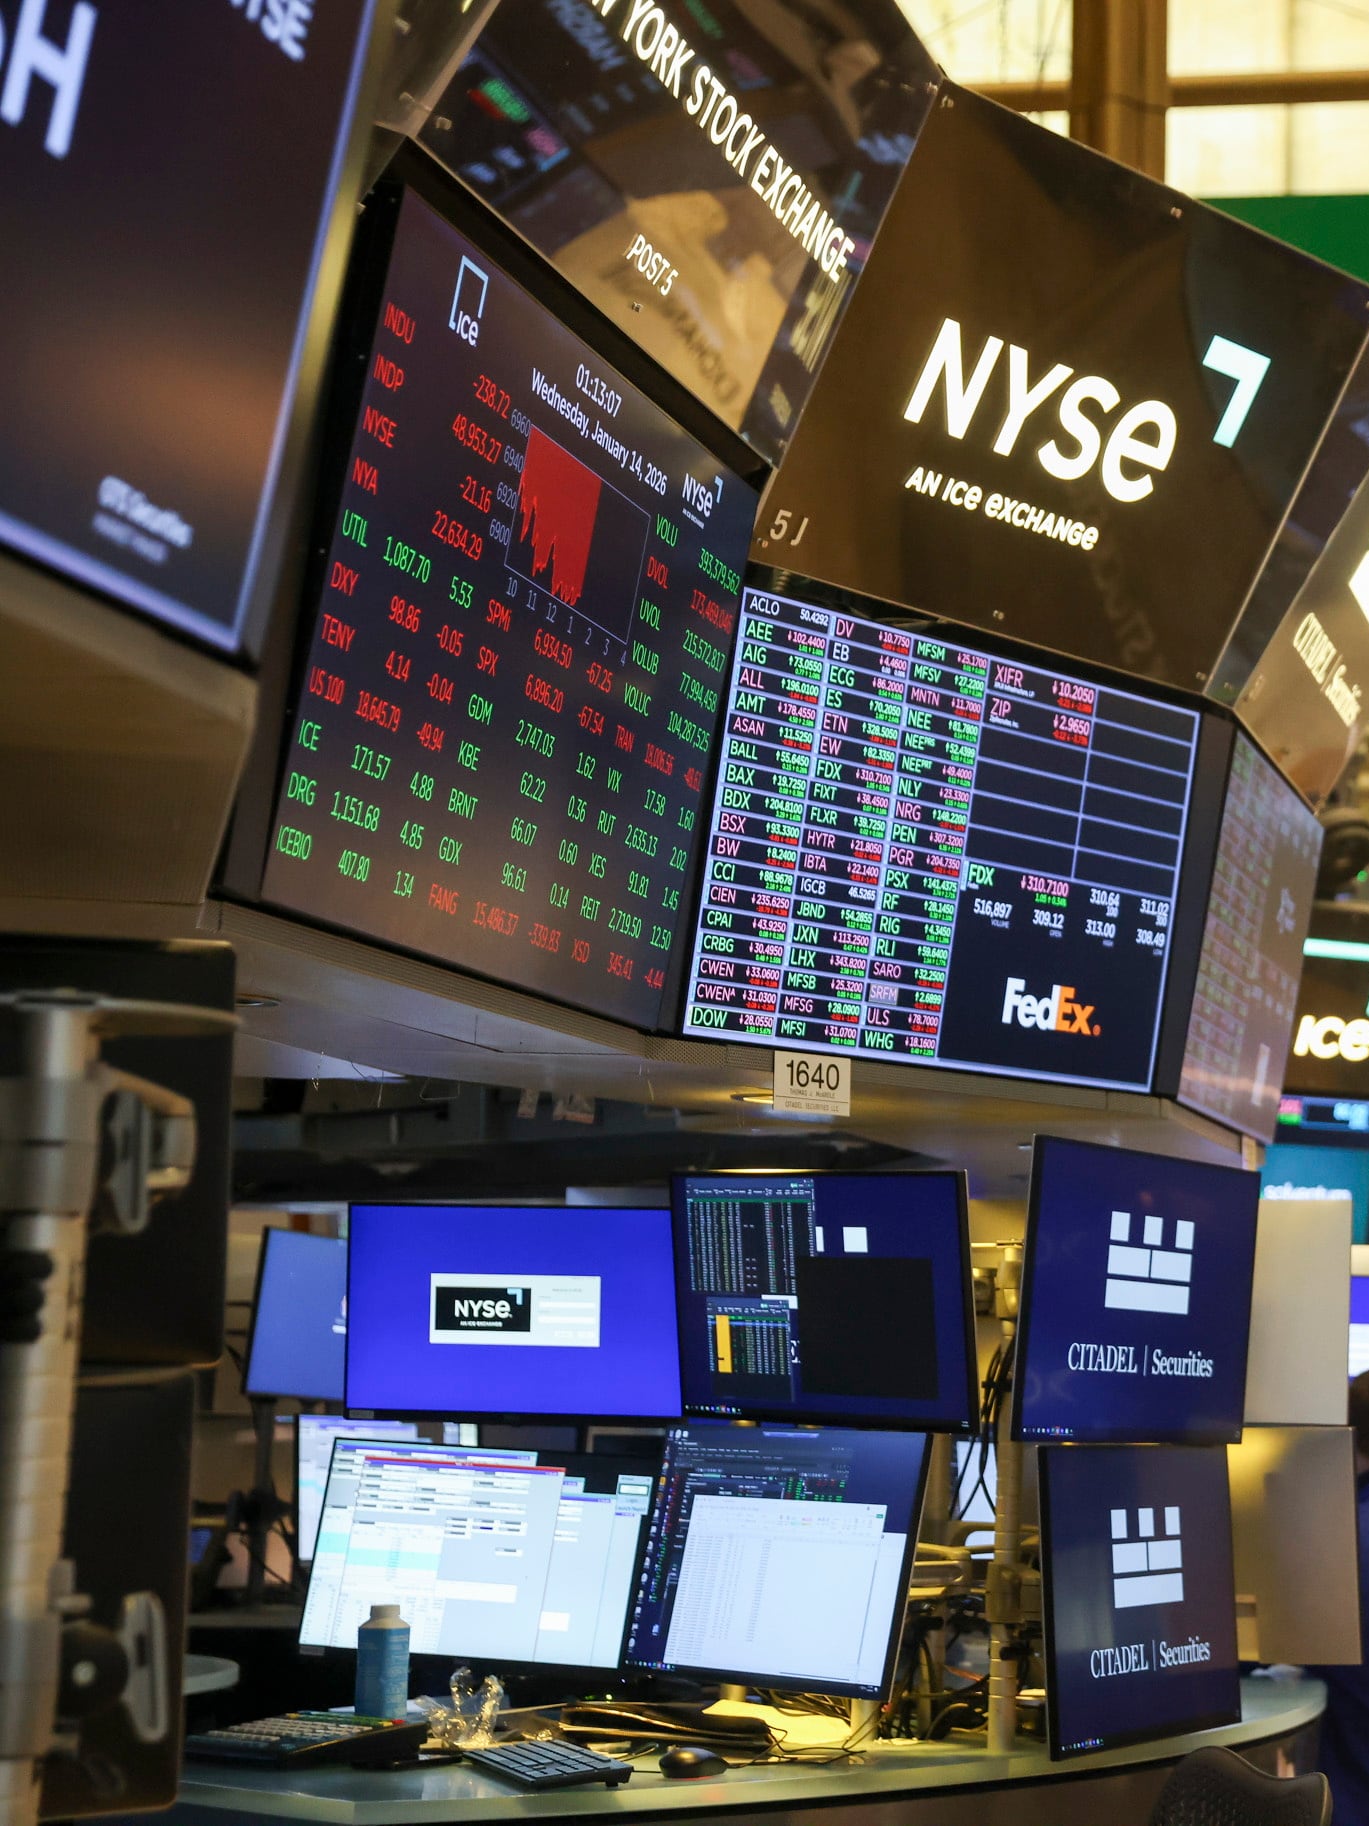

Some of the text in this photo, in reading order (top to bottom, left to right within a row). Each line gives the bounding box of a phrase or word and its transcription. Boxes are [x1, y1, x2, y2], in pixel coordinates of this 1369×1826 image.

[624, 0, 855, 283] YORK STOCK EXCHANGE
[627, 234, 678, 296] POST 5
[384, 302, 511, 419] INDU -238.72
[576, 363, 622, 418] 01:13:07
[373, 353, 502, 464] INDP 48,953.27
[531, 367, 668, 496] Wednesday, January 14, 2026
[363, 406, 492, 513] NYSE -21.16
[905, 467, 940, 495] AN
[352, 457, 483, 560] NYA 22,634.29
[656, 514, 679, 547] VOLU
[770, 509, 809, 546] 5 J
[342, 509, 474, 608] UTIL 1,087.70 5.53
[330, 562, 463, 656] DXY 98.86 -0.05
[639, 599, 661, 631] UVOL
[750, 596, 780, 615] ACLO
[746, 621, 774, 642] AEE
[835, 619, 854, 638] DV
[633, 640, 659, 675] VOLUB
[743, 645, 767, 664] AIG
[833, 643, 849, 662] EB
[917, 641, 945, 661] MFSM
[1293, 612, 1337, 684] CITADEL
[321, 614, 454, 704] TENY 4.14 -0.04
[476, 646, 499, 677] SPX
[740, 669, 764, 689] ALL
[829, 665, 855, 687] ECG
[914, 664, 941, 683] MFSV
[995, 664, 1024, 688] XIFR
[1059, 682, 1094, 704] 10.2050
[624, 683, 651, 717] VOLUC
[736, 693, 766, 713] AMT
[826, 689, 843, 708] ES
[911, 687, 939, 706] MNTN
[468, 694, 493, 726] GDM
[990, 698, 1012, 717] ZIP
[733, 717, 764, 736] ASAN
[823, 713, 848, 733] ETN
[908, 709, 932, 730] NEE
[458, 740, 481, 771] KBE
[730, 742, 758, 760] BALL
[820, 737, 841, 755] EW
[299, 720, 434, 801] ICE 171.57 4.88
[817, 758, 842, 780] FDX
[727, 764, 755, 786] BAX
[814, 784, 837, 800] FIXT
[899, 779, 922, 798] NLY
[448, 788, 478, 820] BRNT
[723, 788, 751, 810] BDX
[288, 772, 424, 849] DRG 1,151.68 4.85
[810, 807, 837, 825] FLXR
[896, 801, 921, 821] NRG
[720, 812, 746, 833] BSX
[807, 830, 835, 848] HYTR
[893, 824, 916, 843] PEN
[439, 836, 462, 865] GDX
[717, 837, 740, 856] BW
[804, 855, 827, 871] IBTA
[889, 847, 914, 867] PGR
[714, 862, 735, 882] CCI
[886, 870, 909, 889] PSX
[968, 863, 995, 886] FDX
[710, 886, 736, 904] CIEN
[801, 878, 826, 895] IGCB
[797, 902, 825, 919] JBND
[883, 892, 899, 910] RF
[707, 910, 732, 928] CPAI
[974, 899, 1064, 929] 516,897 309.12
[794, 925, 819, 944] JXN
[880, 916, 900, 934] RIG
[704, 934, 734, 952] CRBG
[877, 938, 895, 957] RLI
[701, 959, 734, 977] CWEN
[790, 948, 816, 968] LHX
[788, 972, 816, 989] MFSB
[873, 963, 901, 979] SARO
[784, 996, 813, 1013] MFSG
[1002, 977, 1095, 1035] FedEx
[693, 1007, 727, 1028] DOW
[867, 1007, 890, 1025] ULS
[781, 1020, 805, 1036] MFSI
[865, 1030, 894, 1050] WHG
[786, 1060, 839, 1090] 1640
[1068, 1342, 1214, 1378] CITADEL Securities
[1090, 1635, 1210, 1679] CITADEL Securities
